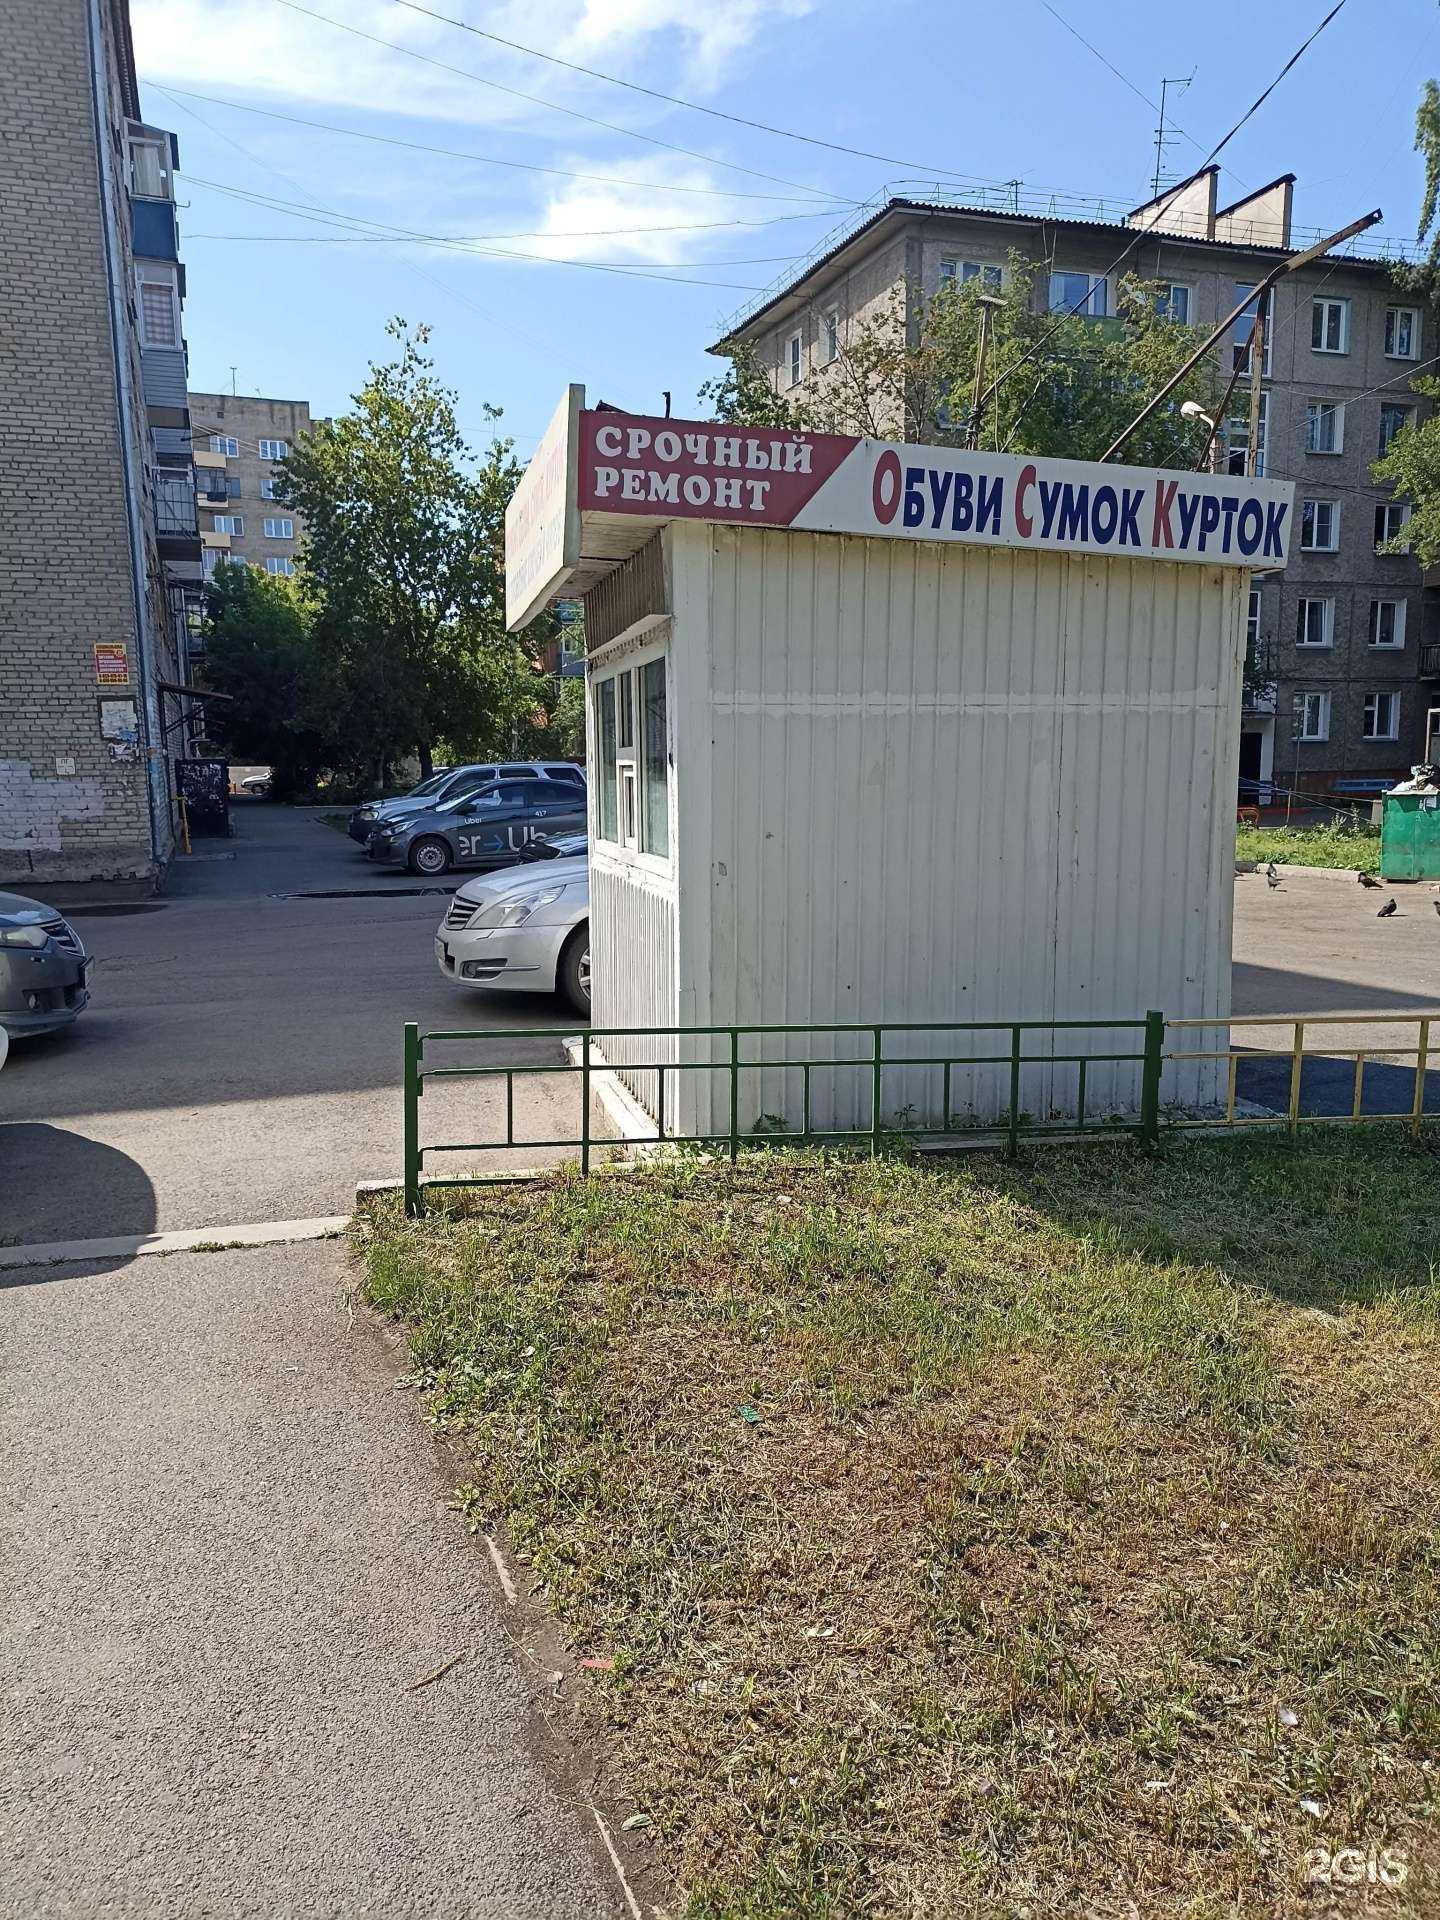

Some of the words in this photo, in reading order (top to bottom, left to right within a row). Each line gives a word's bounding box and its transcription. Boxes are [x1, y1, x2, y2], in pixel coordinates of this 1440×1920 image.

[595, 425, 813, 474] СРОЧНЫЙ
[594, 466, 771, 511] РЕМОНТ
[872, 449, 1003, 536] ОБУВИ
[1014, 464, 1145, 548] СУМОК
[1151, 479, 1288, 558] КУРТОК
[464, 817, 482, 825] Uber
